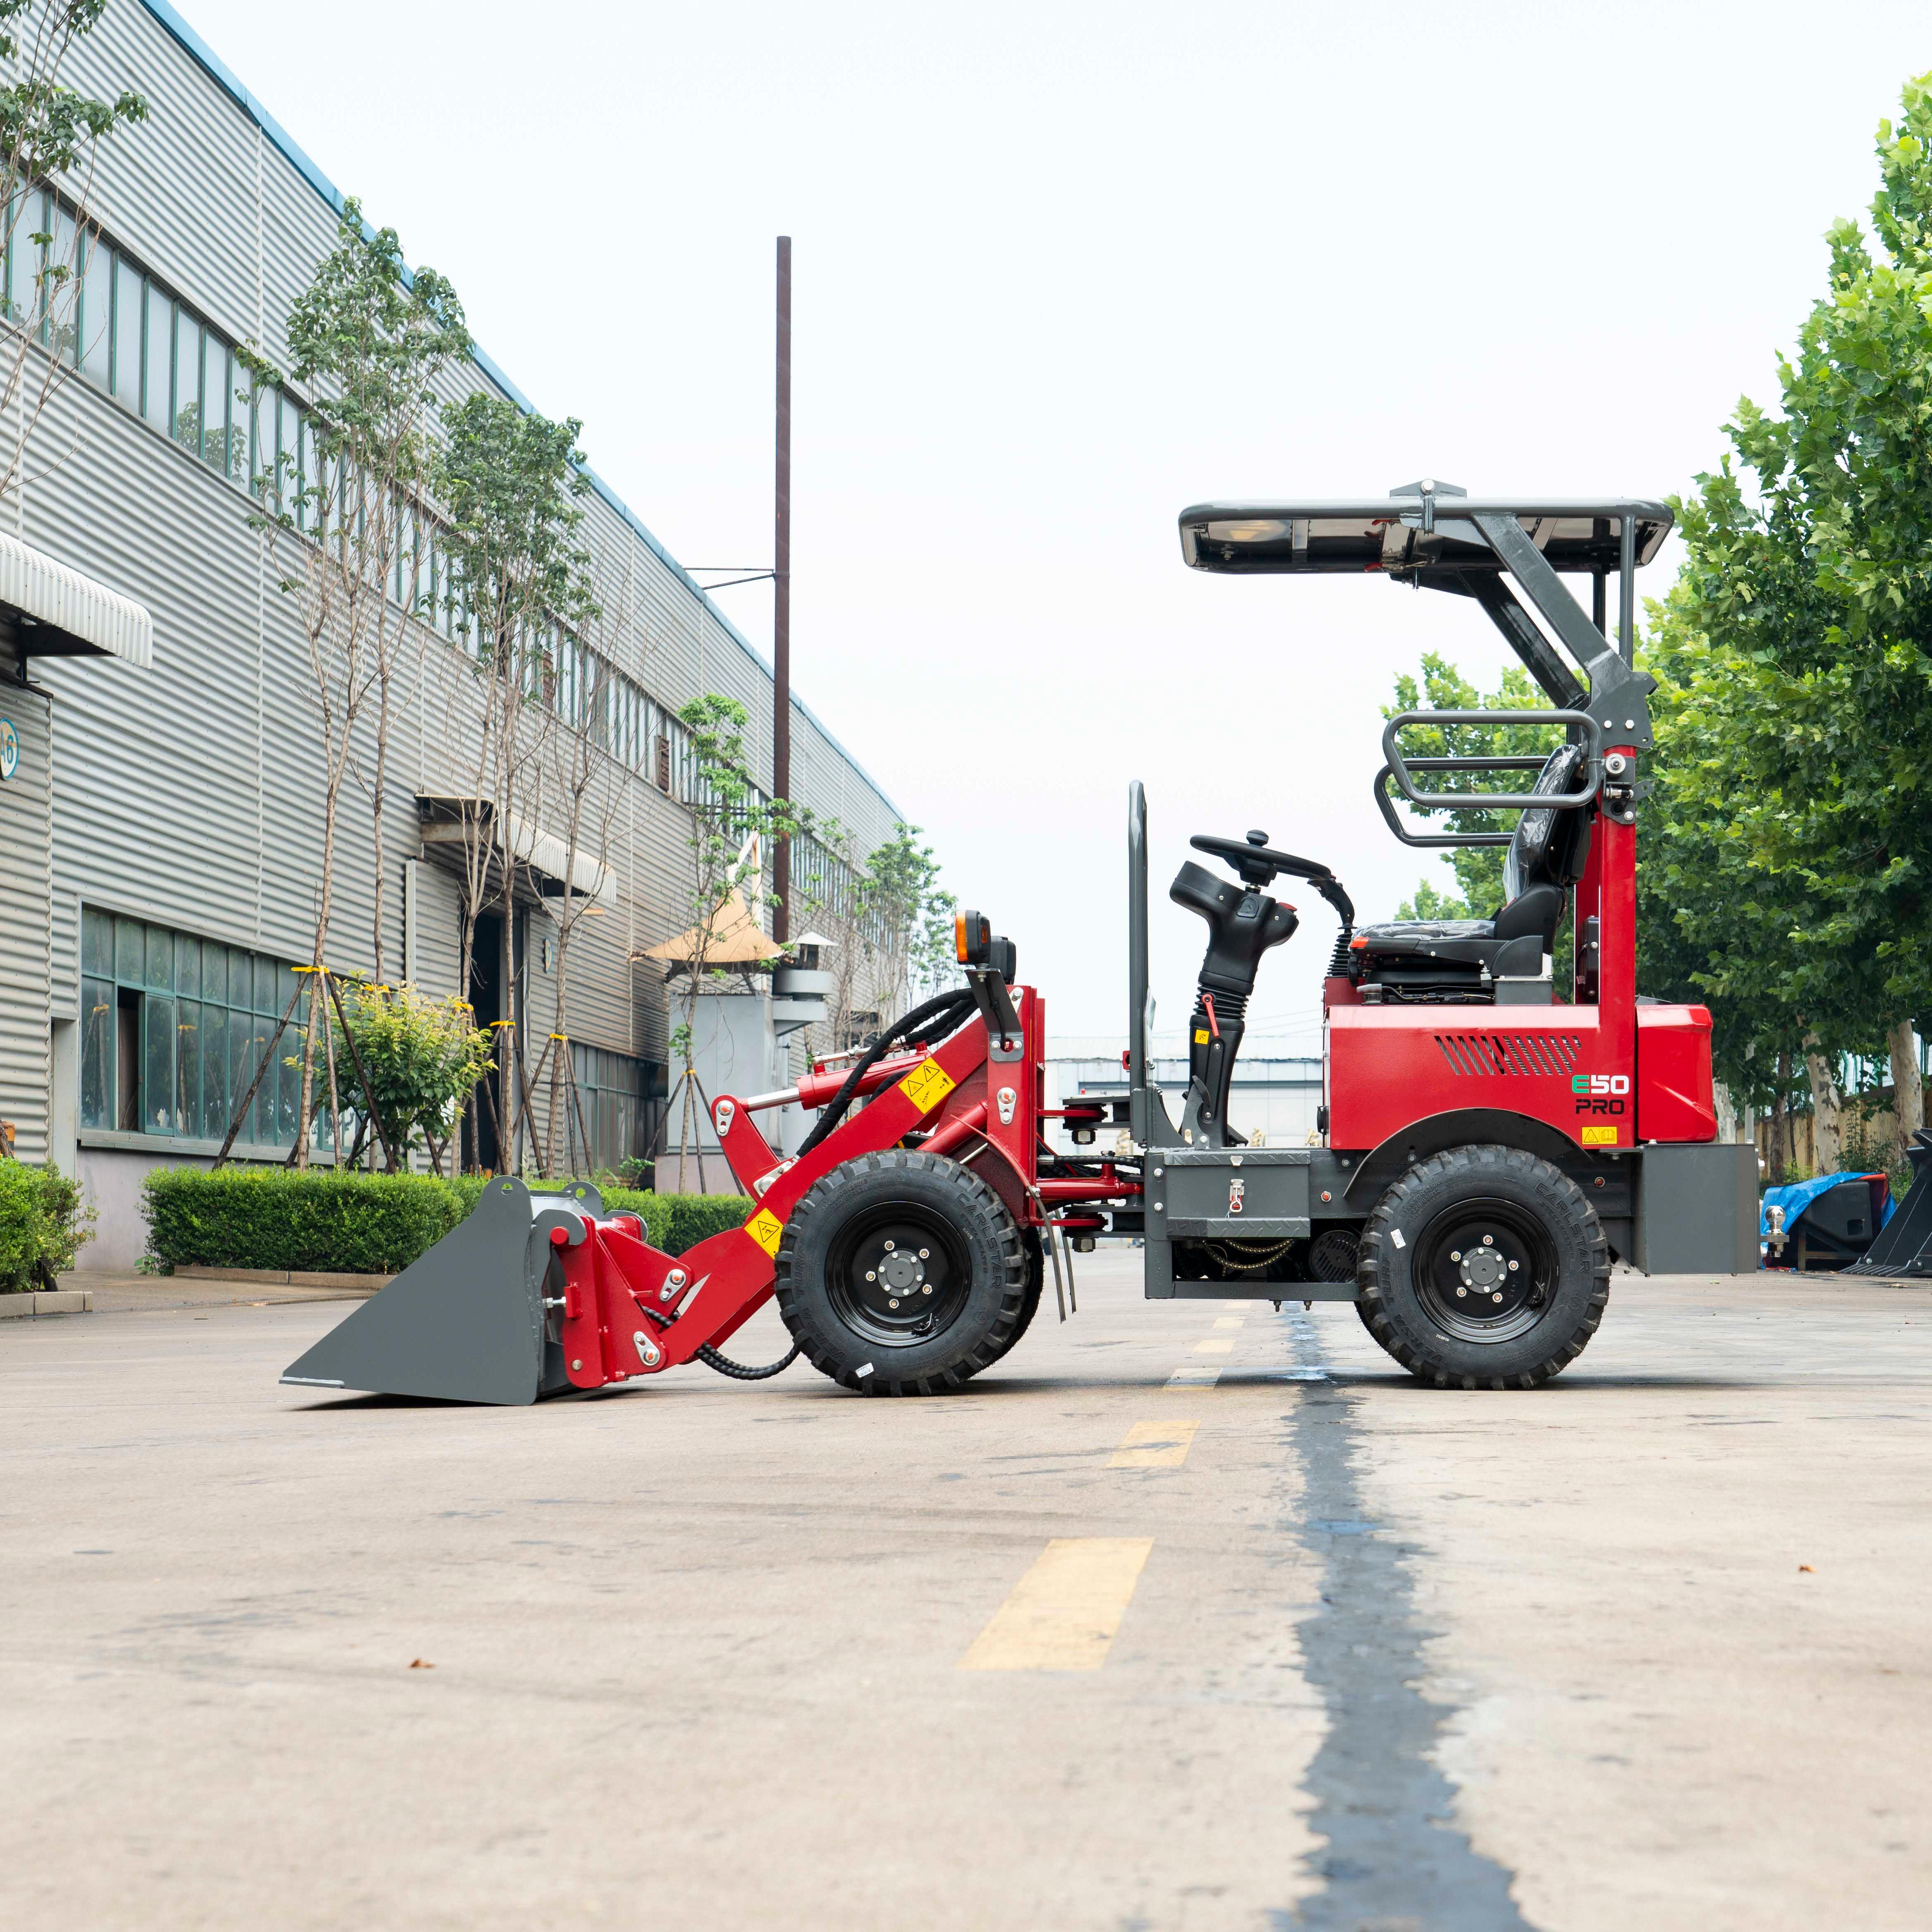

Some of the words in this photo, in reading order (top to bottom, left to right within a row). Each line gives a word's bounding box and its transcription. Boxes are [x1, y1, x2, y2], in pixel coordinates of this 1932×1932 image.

[1571, 1075, 1629, 1094] E50
[1576, 1099, 1624, 1114] PRO
[956, 1193, 1002, 1288] CARLSTAR
[1535, 1182, 1591, 1273] CARLSTAR
[1392, 1314, 1444, 1362] VERSA
